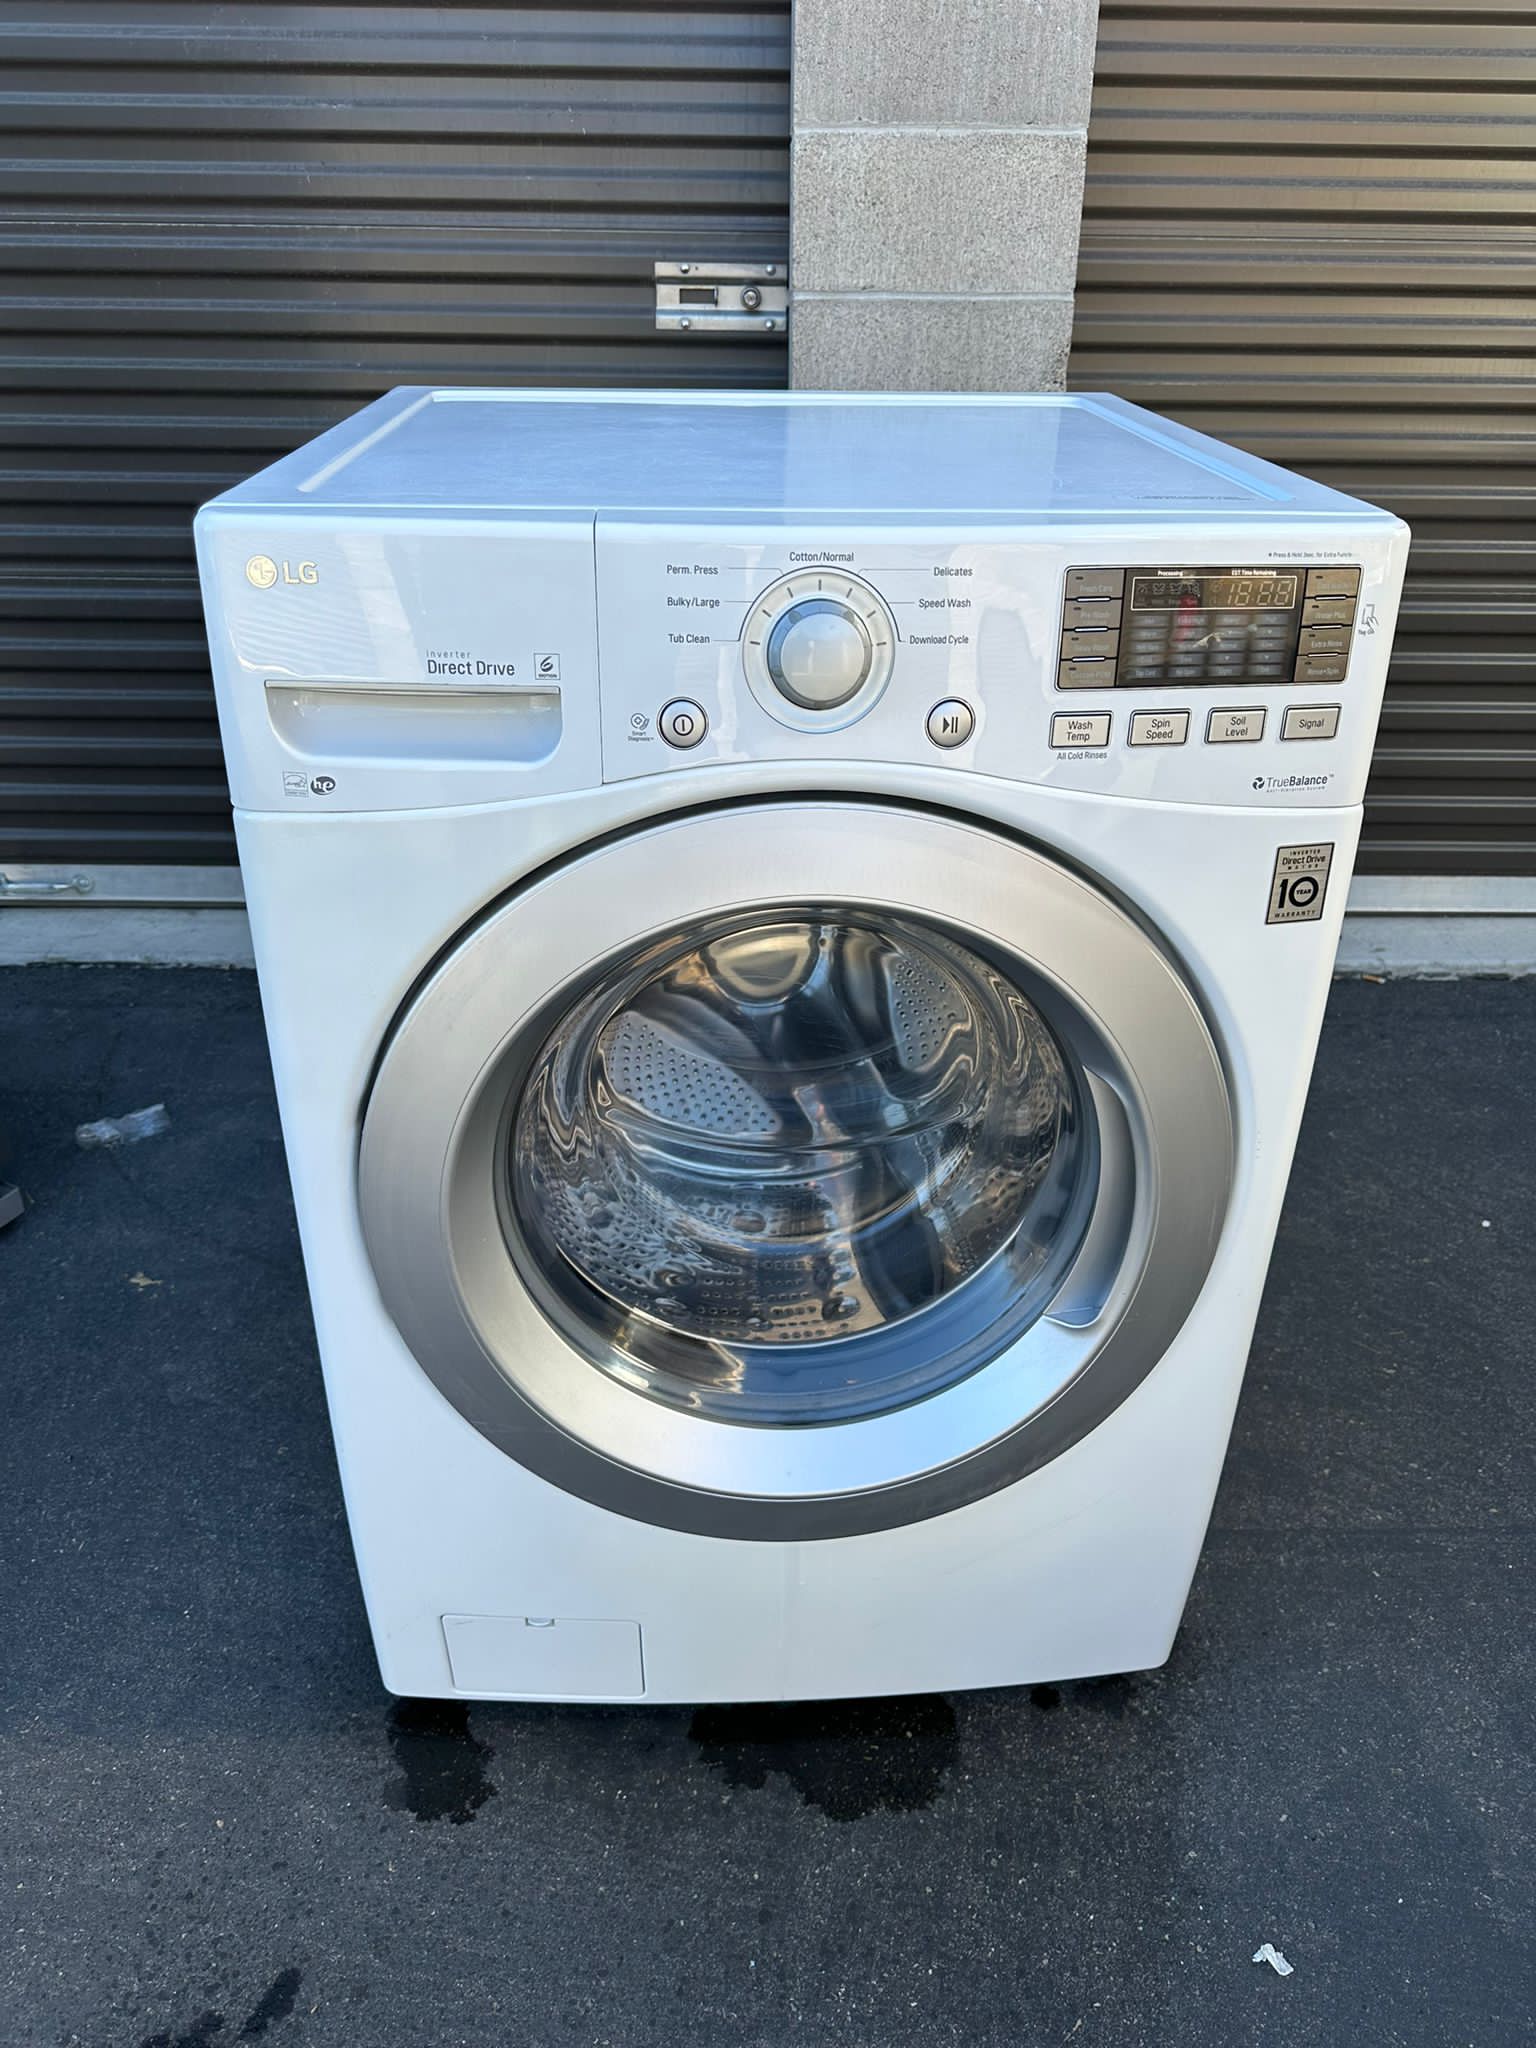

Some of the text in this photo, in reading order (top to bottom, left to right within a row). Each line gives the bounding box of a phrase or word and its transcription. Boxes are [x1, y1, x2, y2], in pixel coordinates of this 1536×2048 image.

[789, 551, 855, 562] Cotton/Normal
[283, 561, 319, 585] LG
[667, 565, 719, 576] Perm. Press
[933, 567, 973, 577] Delicates
[667, 597, 720, 608] Bulky/Large
[919, 598, 971, 609] Speed Wash
[668, 633, 710, 643] Tub Clean
[909, 635, 969, 646] Download Cycle
[427, 659, 515, 676] Direct Drive
[1067, 720, 1093, 730] Wash
[1151, 718, 1171, 729] Spin
[1230, 716, 1246, 727] Soil
[1299, 718, 1325, 730] Signal
[1066, 731, 1091, 743] Temp
[1146, 728, 1173, 741] Speed
[1225, 727, 1248, 737] Level
[1057, 751, 1107, 760] All Cold Rinses
[1282, 854, 1326, 865] Direct Drive
[1278, 876, 1319, 908] 10
[1274, 910, 1316, 919] WARRANTY
